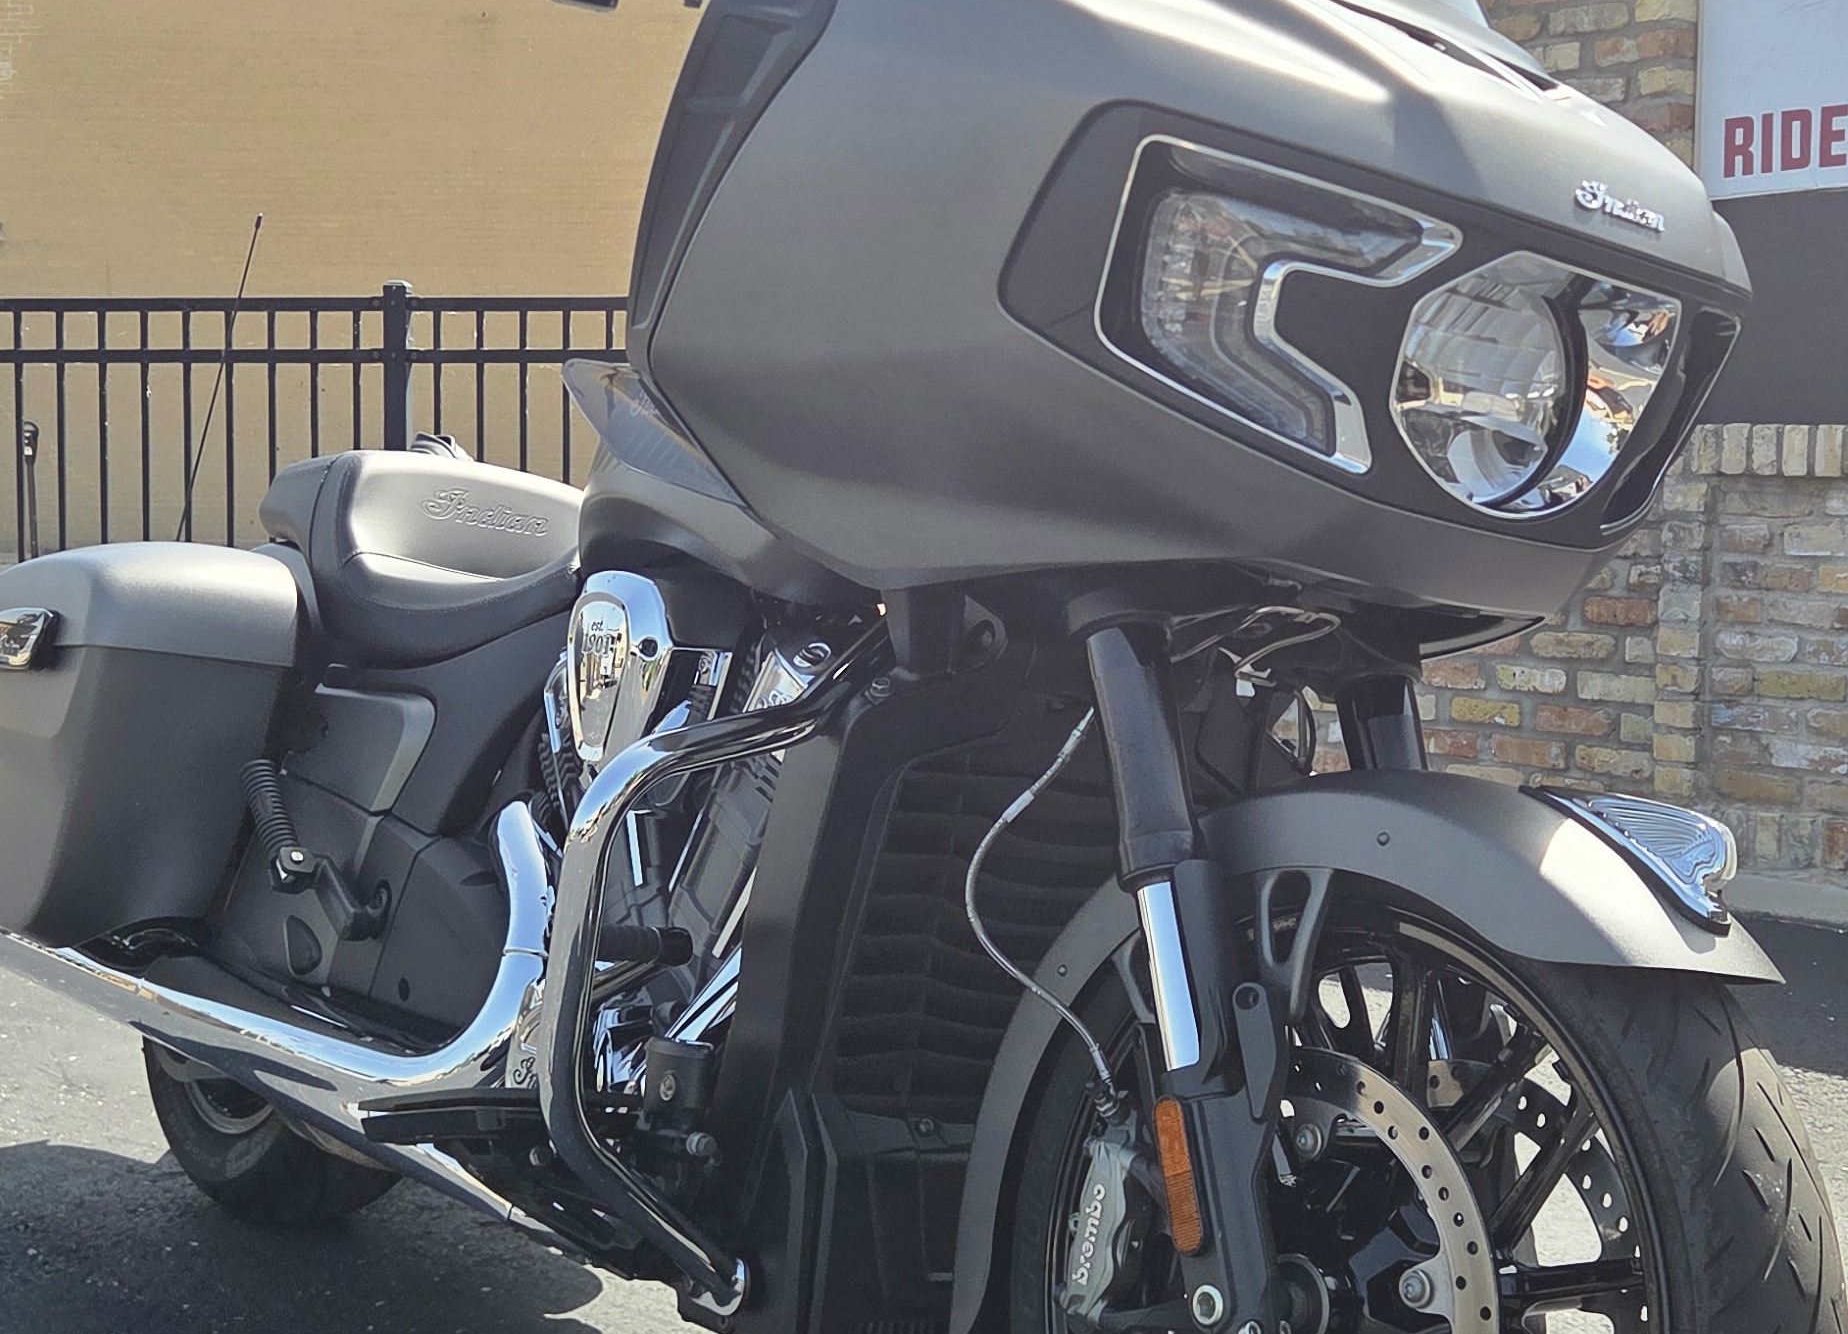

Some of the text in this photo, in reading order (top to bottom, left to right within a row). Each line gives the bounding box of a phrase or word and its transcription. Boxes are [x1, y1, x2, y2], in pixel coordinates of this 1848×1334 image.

[1723, 104, 1848, 178] RIDE
[420, 488, 549, 537] Indian
[1072, 1184, 1106, 1286] brembo
